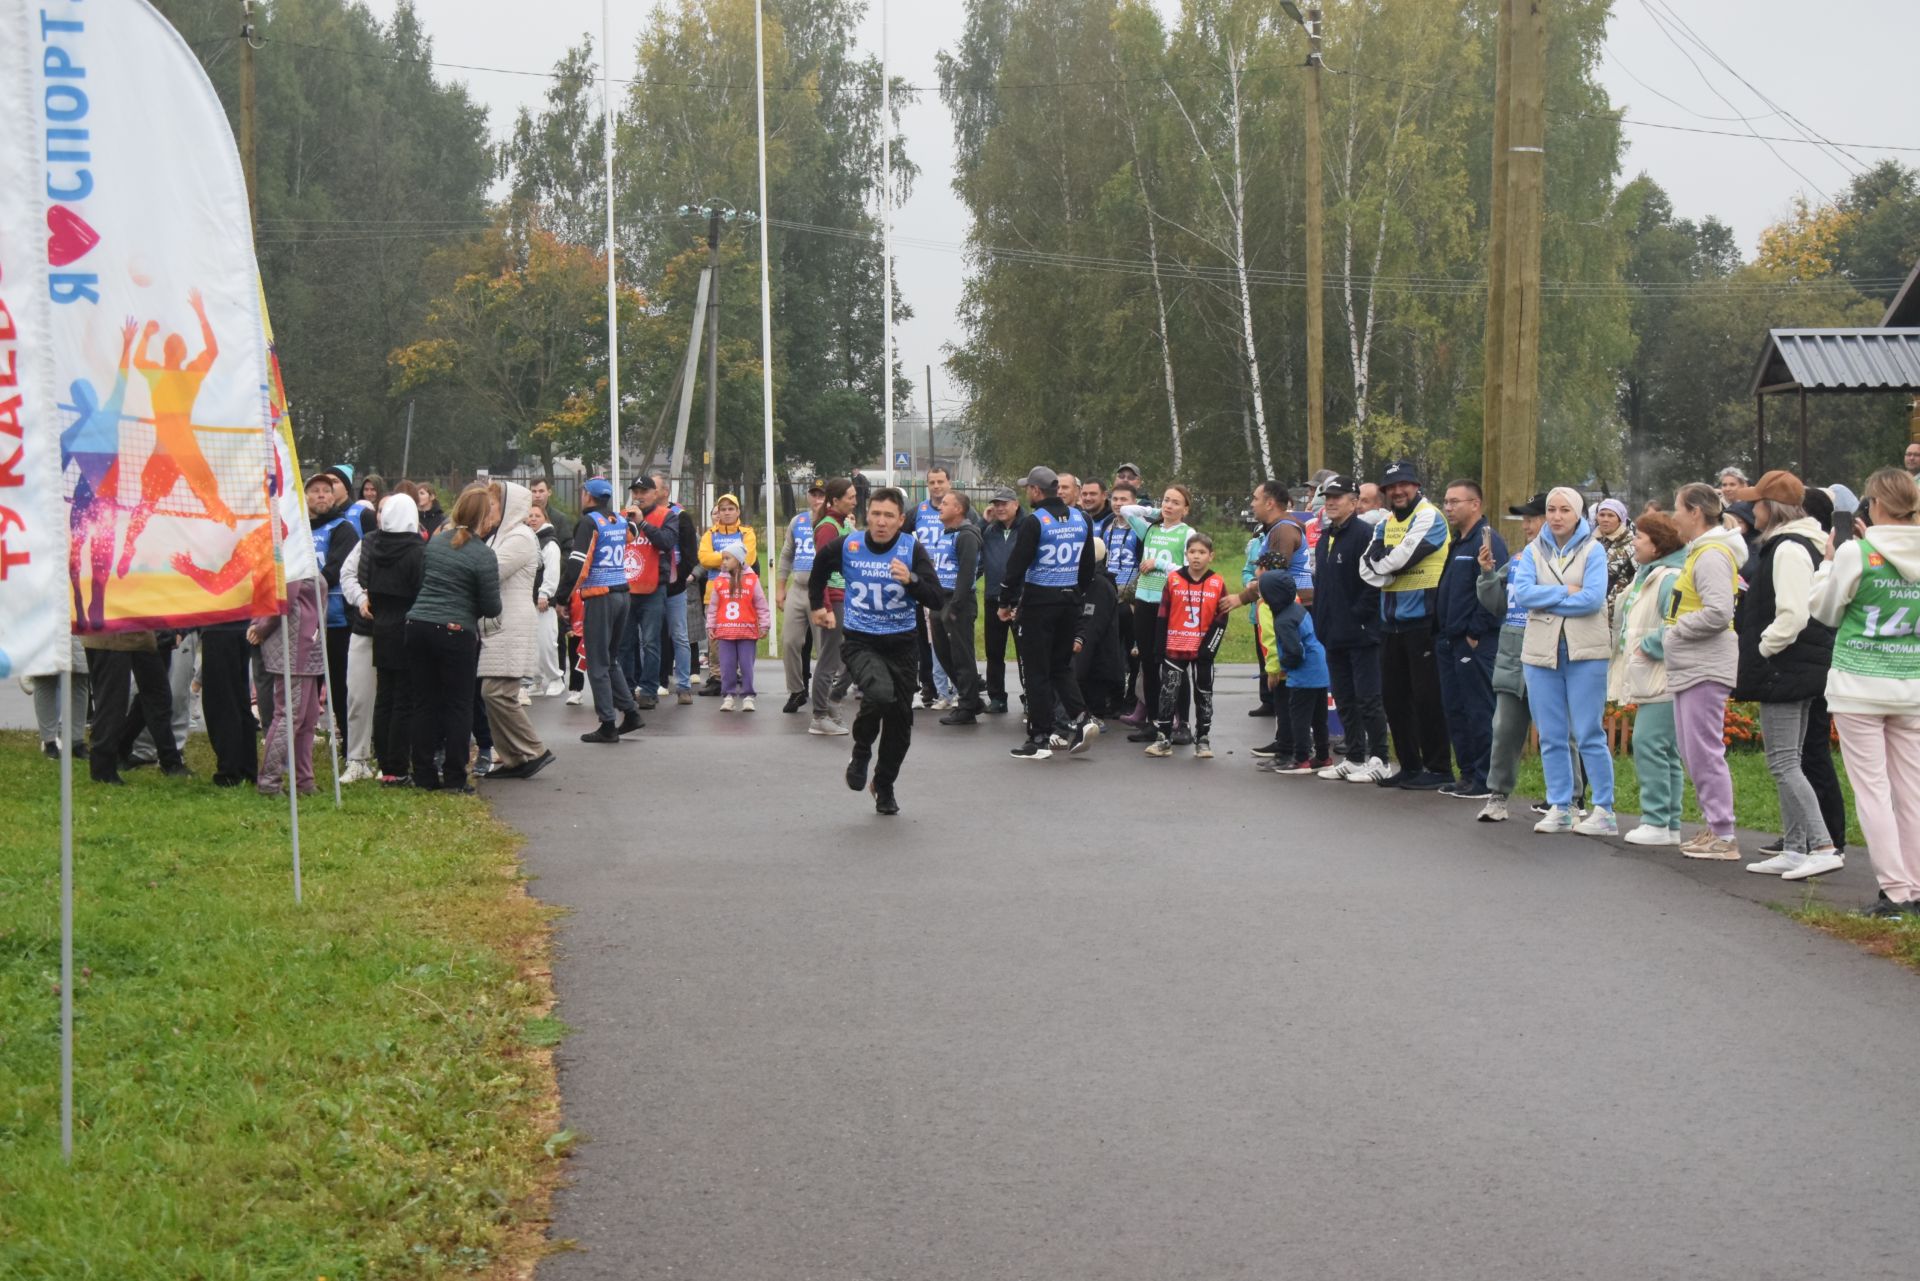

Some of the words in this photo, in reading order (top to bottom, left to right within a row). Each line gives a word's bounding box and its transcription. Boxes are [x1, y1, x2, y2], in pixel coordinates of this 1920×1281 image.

[40, 0, 94, 201] СПОРТ
[48, 273, 100, 305] Я
[917, 526, 946, 544] 21
[599, 544, 627, 566] 20
[1039, 542, 1086, 565] 207
[861, 569, 892, 579] РАЙОН
[850, 582, 907, 610] 212
[725, 602, 740, 620] 8
[1183, 605, 1200, 629] 3
